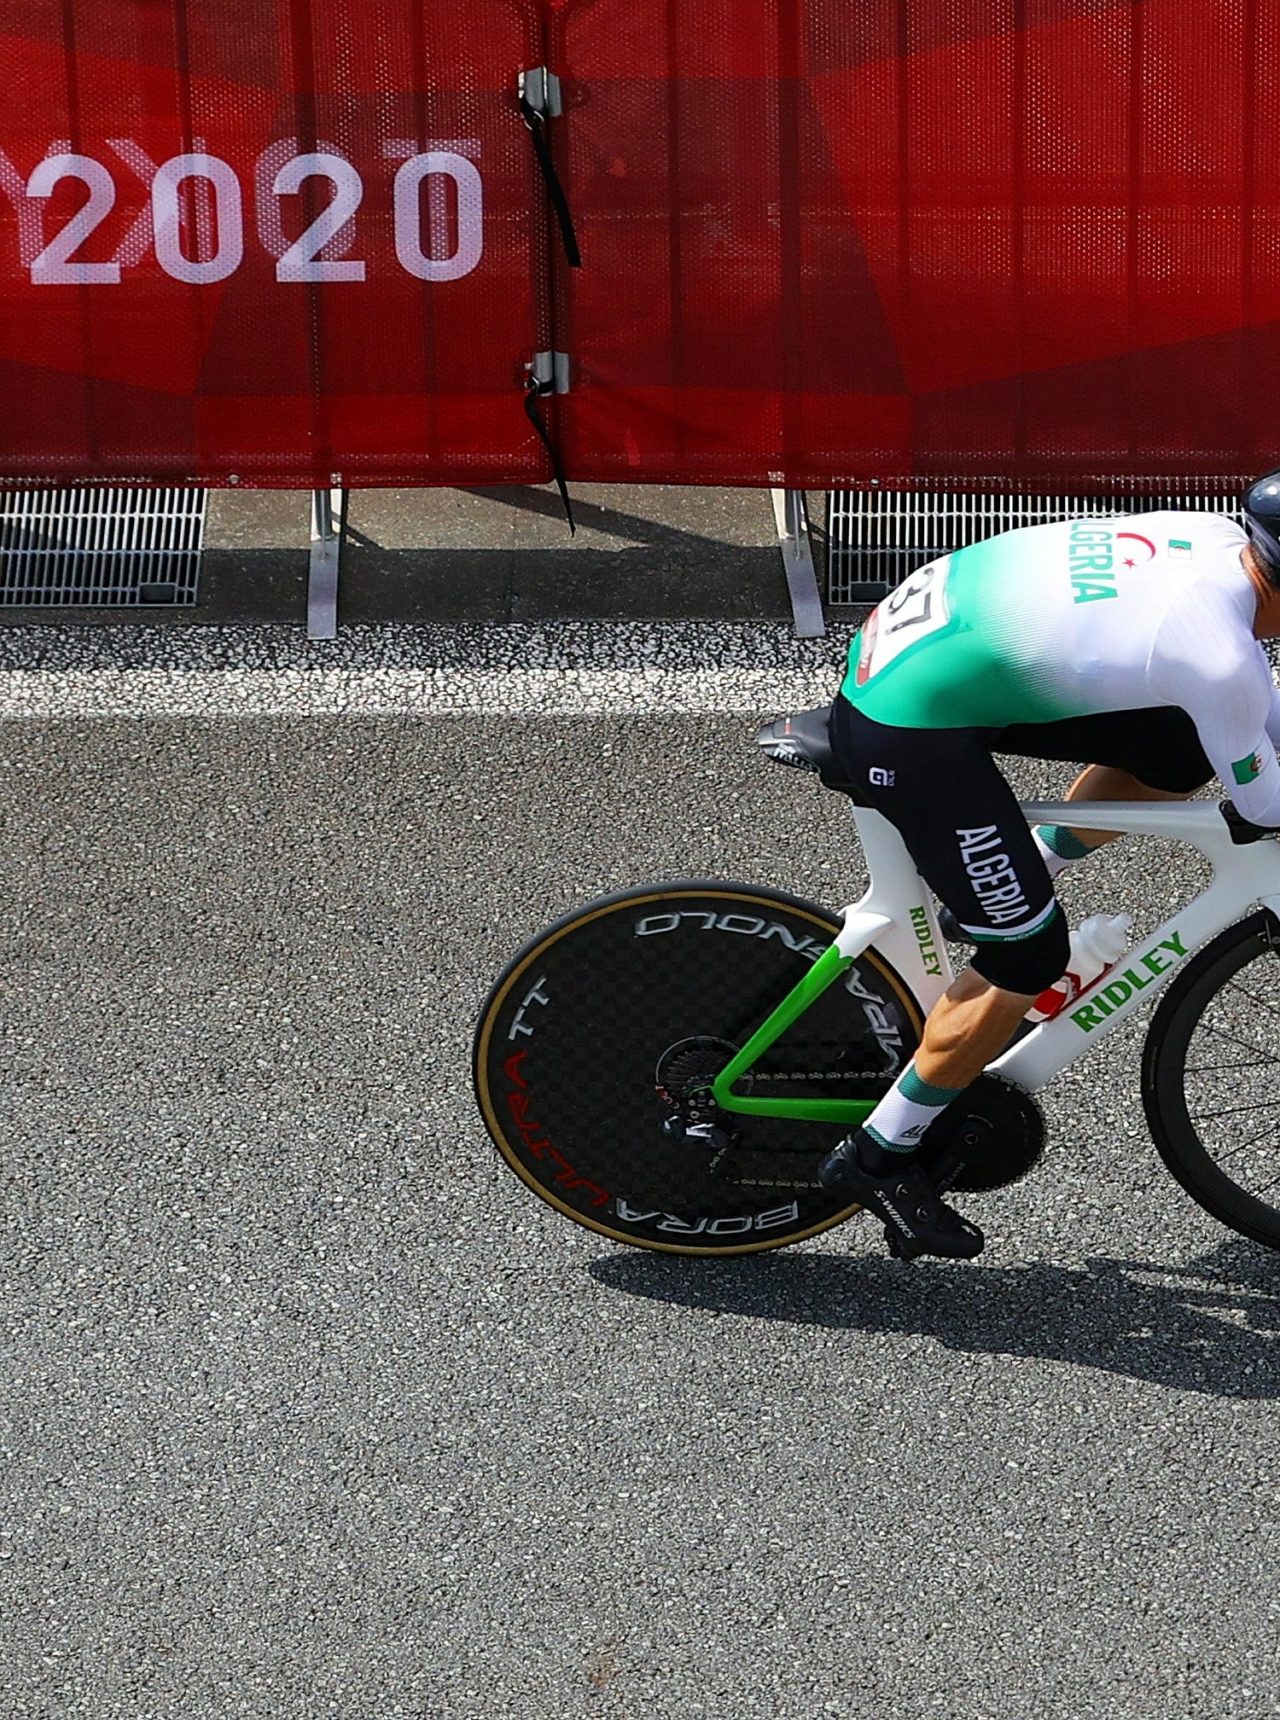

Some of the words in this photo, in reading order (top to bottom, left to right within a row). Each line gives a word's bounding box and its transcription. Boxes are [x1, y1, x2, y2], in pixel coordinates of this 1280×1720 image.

[26, 152, 484, 284] 2020
[1069, 519, 1118, 604] LGERIA
[955, 824, 1030, 925] ALGERIA
[909, 905, 942, 976] RIDLEY
[1070, 931, 1188, 1033] RIDLEY
[508, 975, 550, 1040] TT
[503, 1049, 612, 1207] ULTRA
[616, 1198, 799, 1235] BORA
[873, 1190, 917, 1239] S-WORKS
